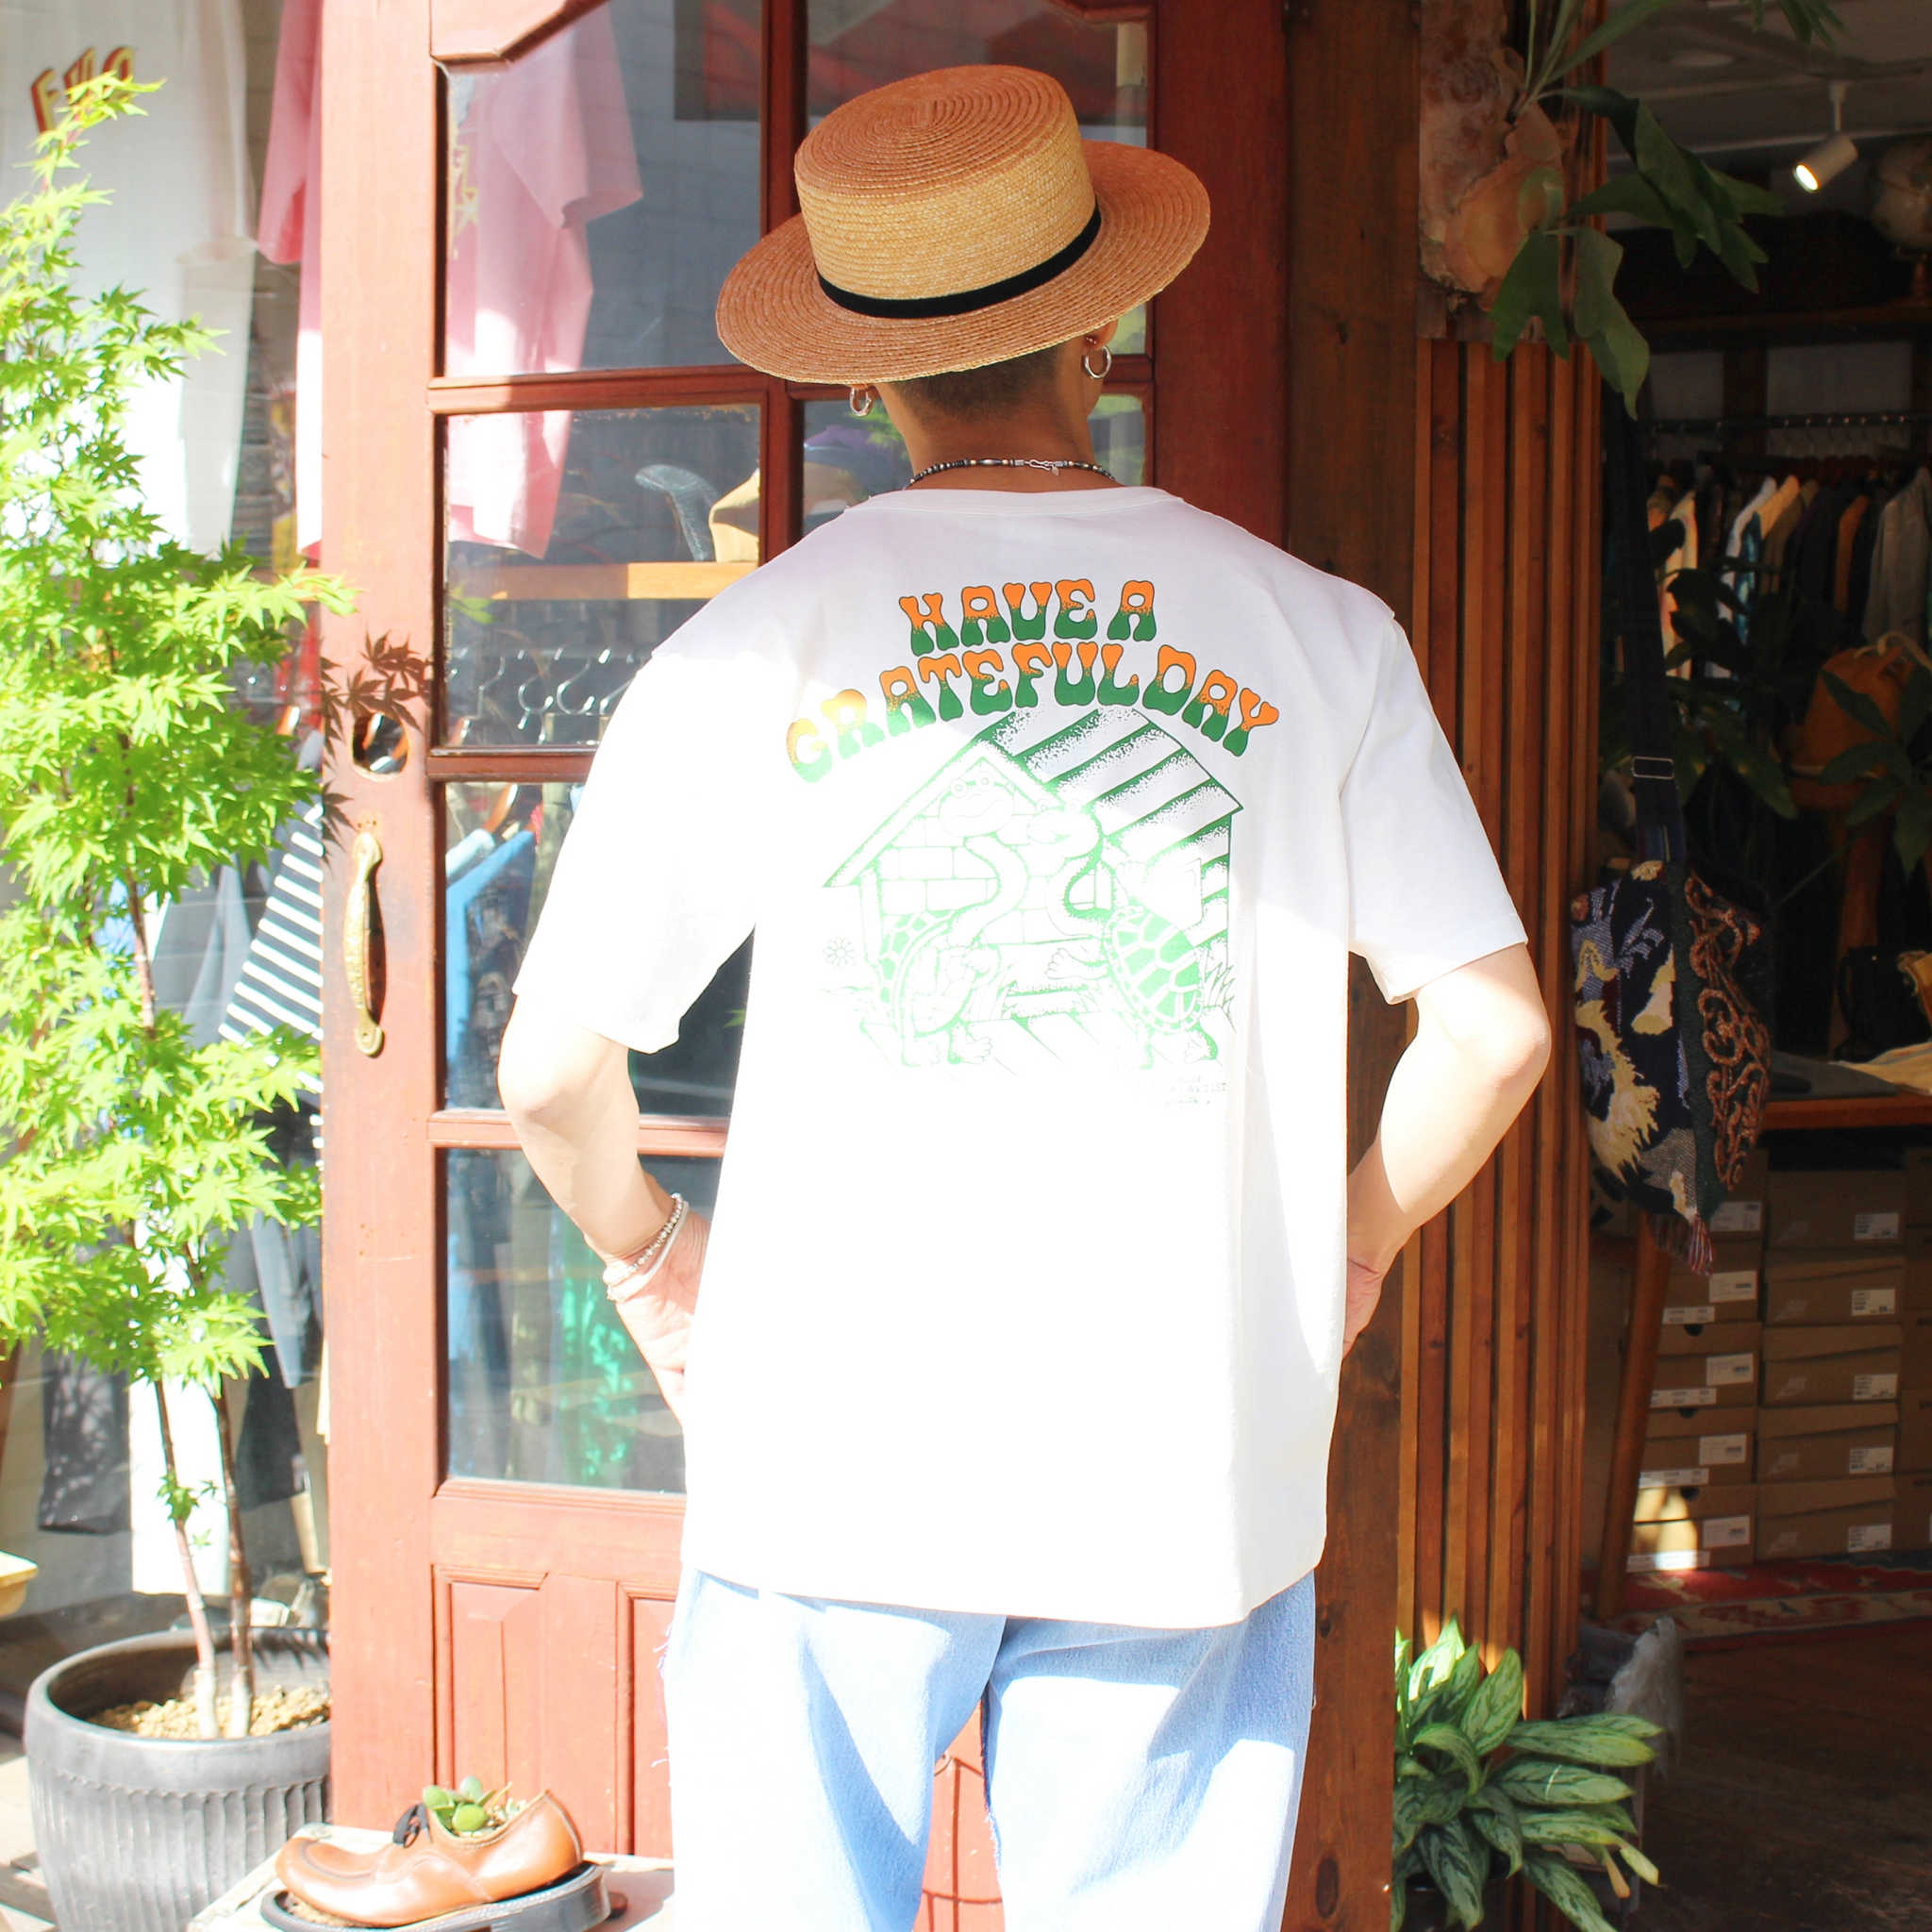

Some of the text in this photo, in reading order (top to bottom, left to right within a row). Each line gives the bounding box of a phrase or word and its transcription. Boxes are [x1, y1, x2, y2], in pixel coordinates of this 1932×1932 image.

[899, 578, 1157, 656] HAVE A
[787, 642, 1278, 782] GRATEFUL DAY
